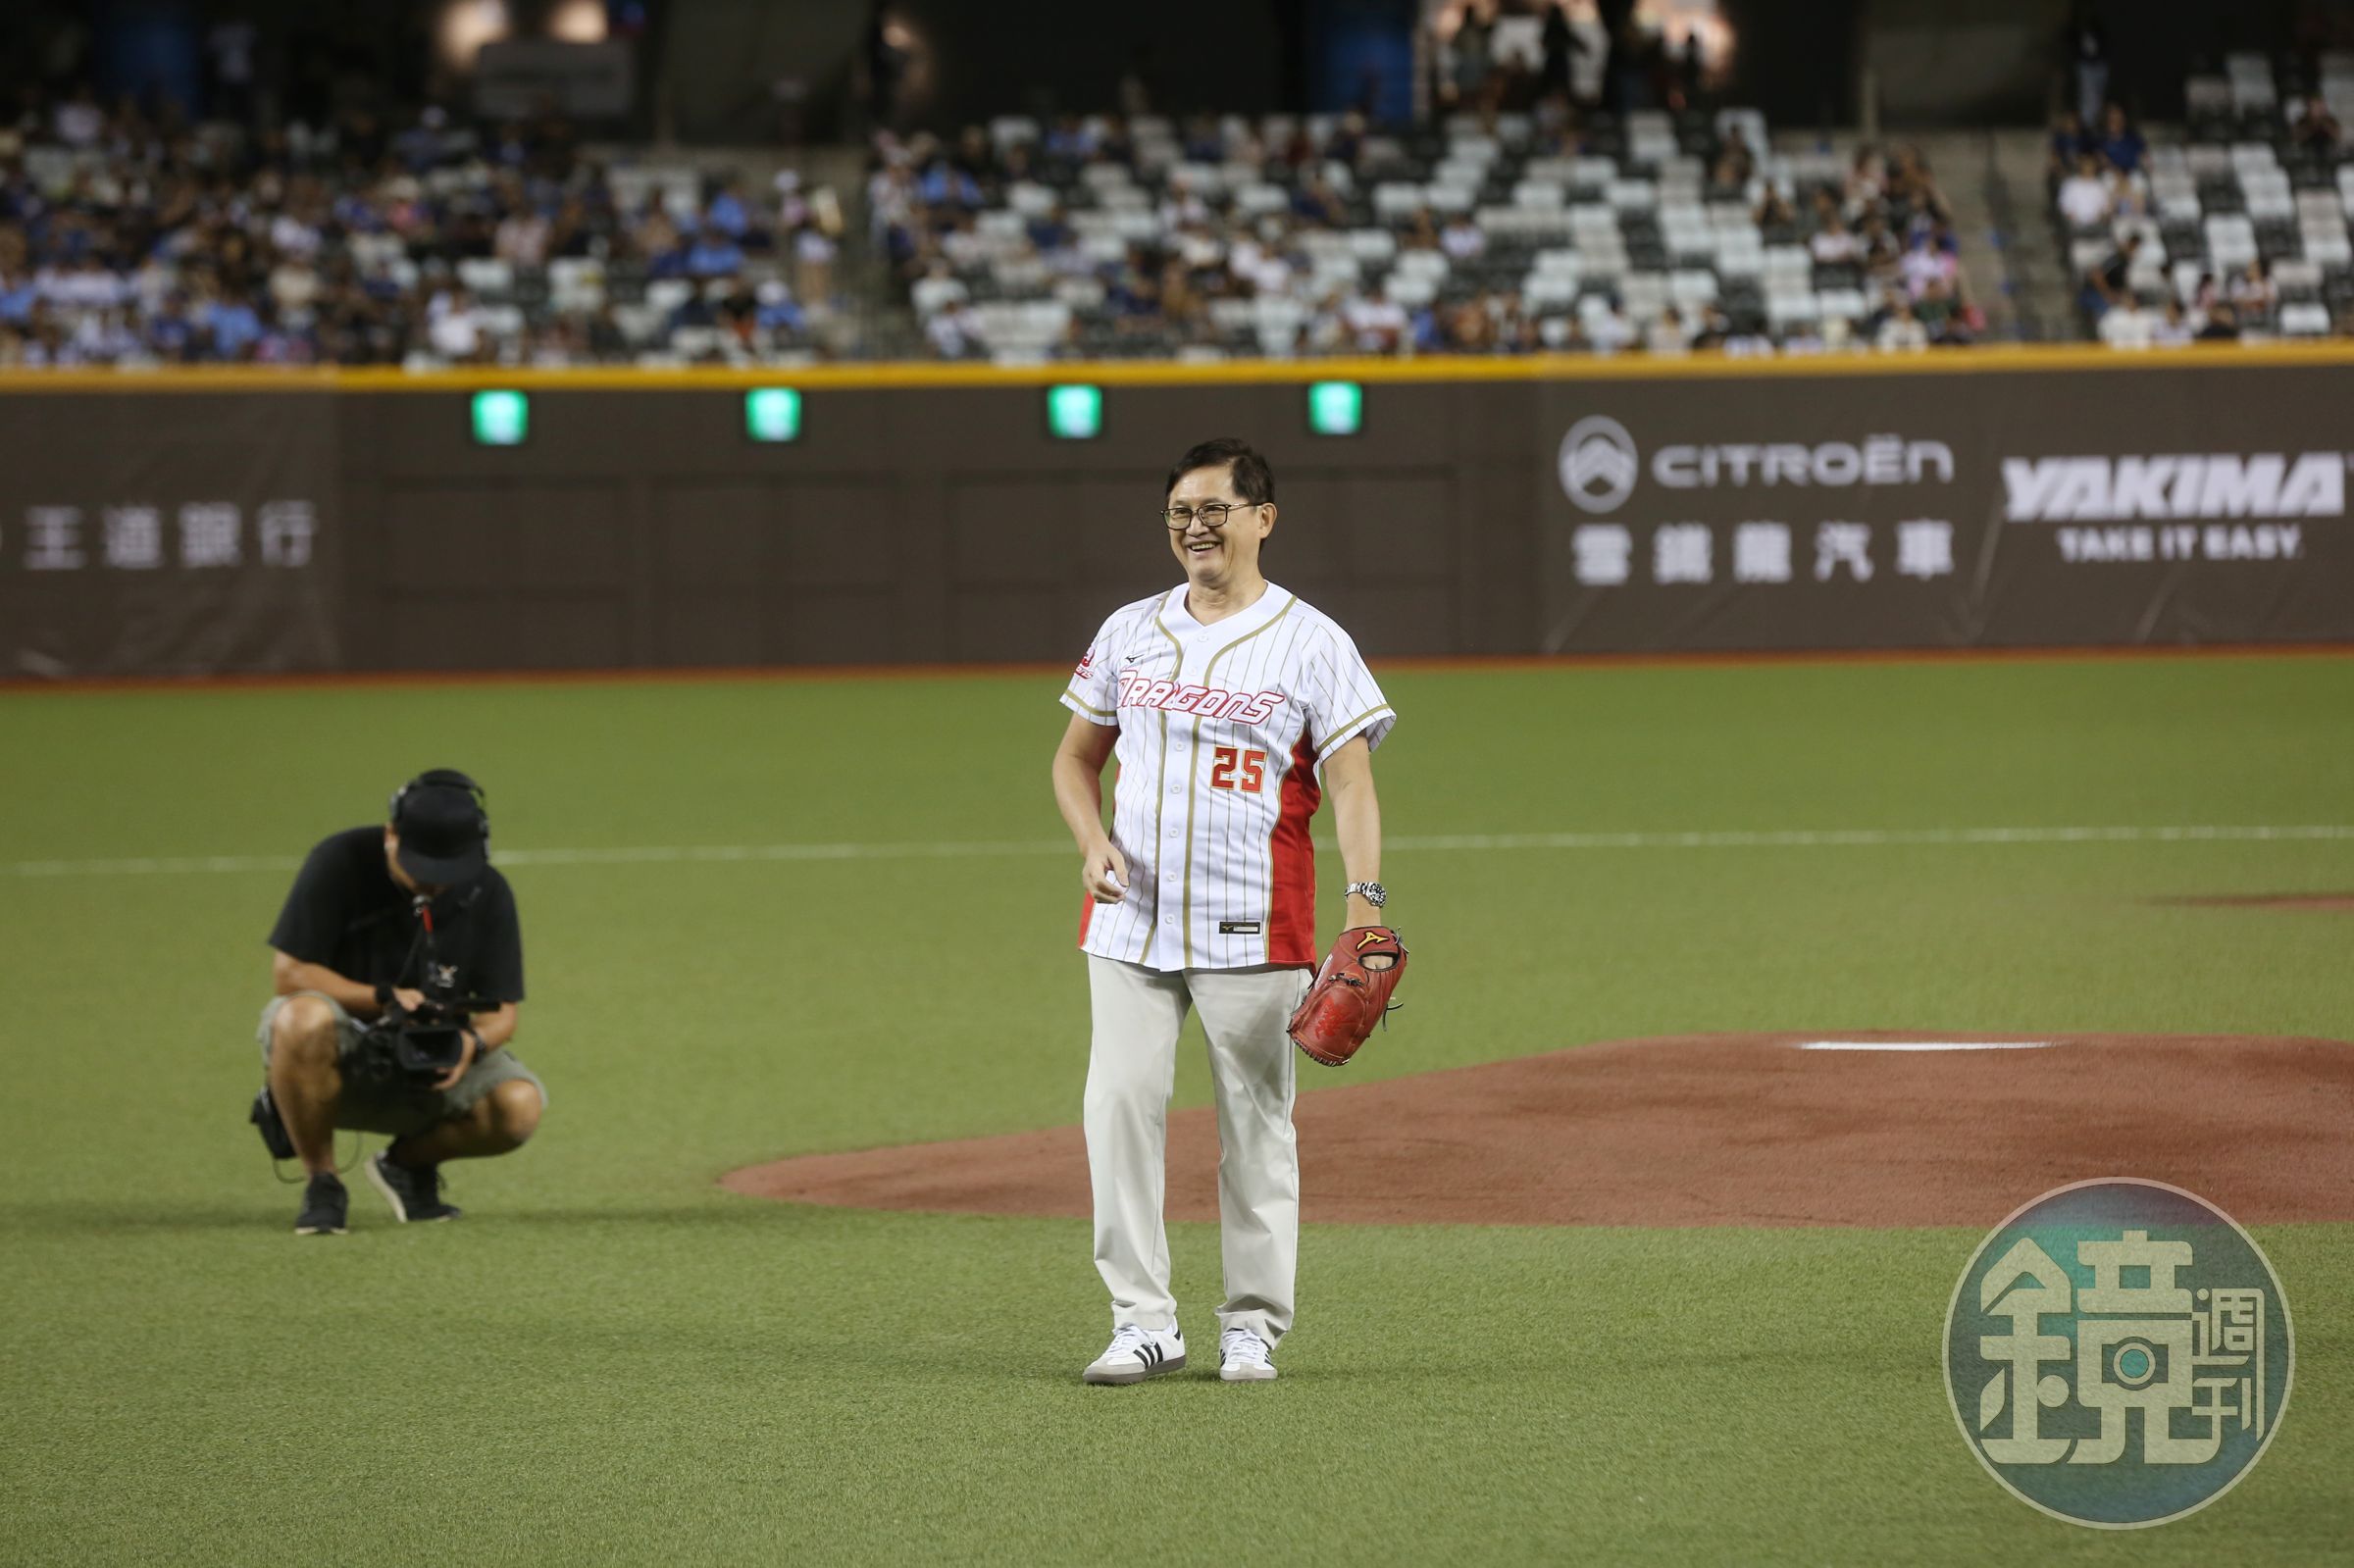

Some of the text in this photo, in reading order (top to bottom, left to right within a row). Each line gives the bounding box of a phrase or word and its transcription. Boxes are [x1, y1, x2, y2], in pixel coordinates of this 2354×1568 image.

[2002, 452, 2345, 521] YAKIMA
[2058, 523, 2301, 562] TAKE IT EASY
[1210, 746, 1266, 793] 25
